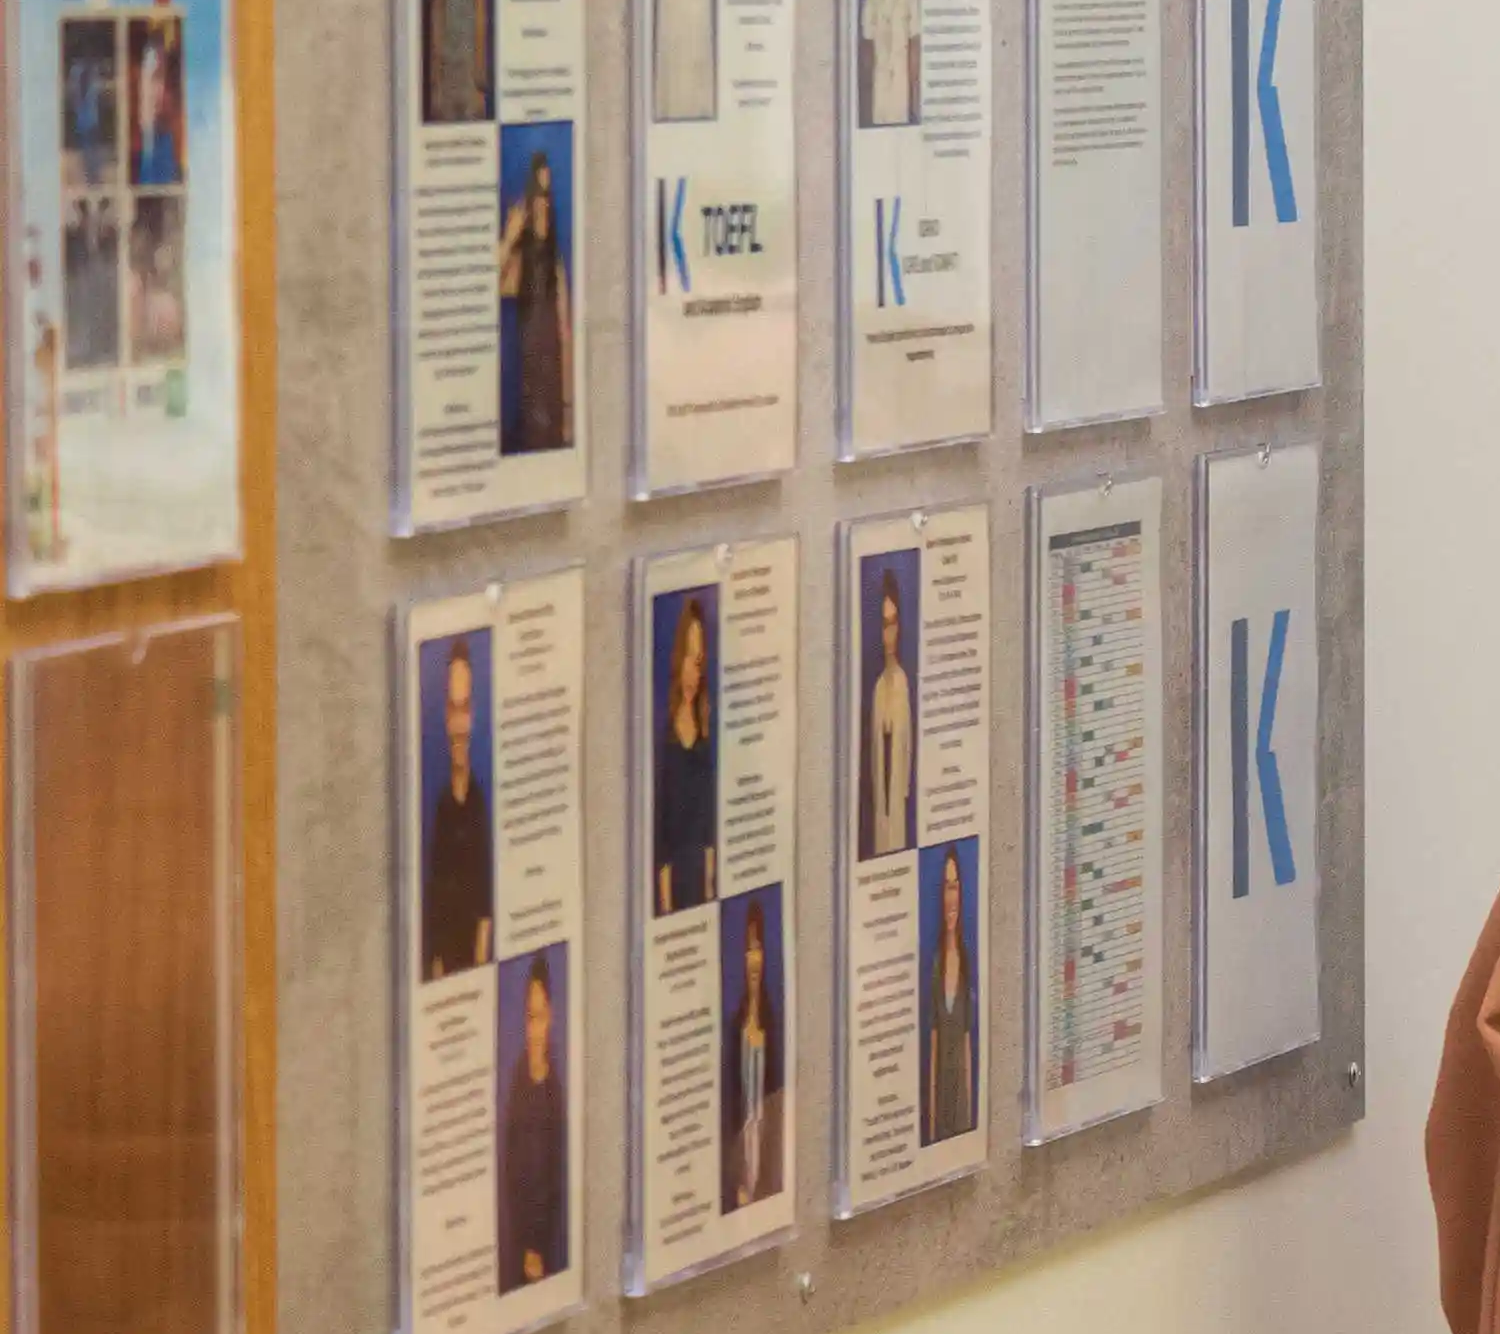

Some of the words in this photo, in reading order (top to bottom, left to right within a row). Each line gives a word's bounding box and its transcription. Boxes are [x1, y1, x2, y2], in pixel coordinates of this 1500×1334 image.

[656, 178, 691, 294] K
[700, 204, 764, 256] TOEFL
[875, 196, 907, 306] K
[1231, 609, 1297, 899] K
